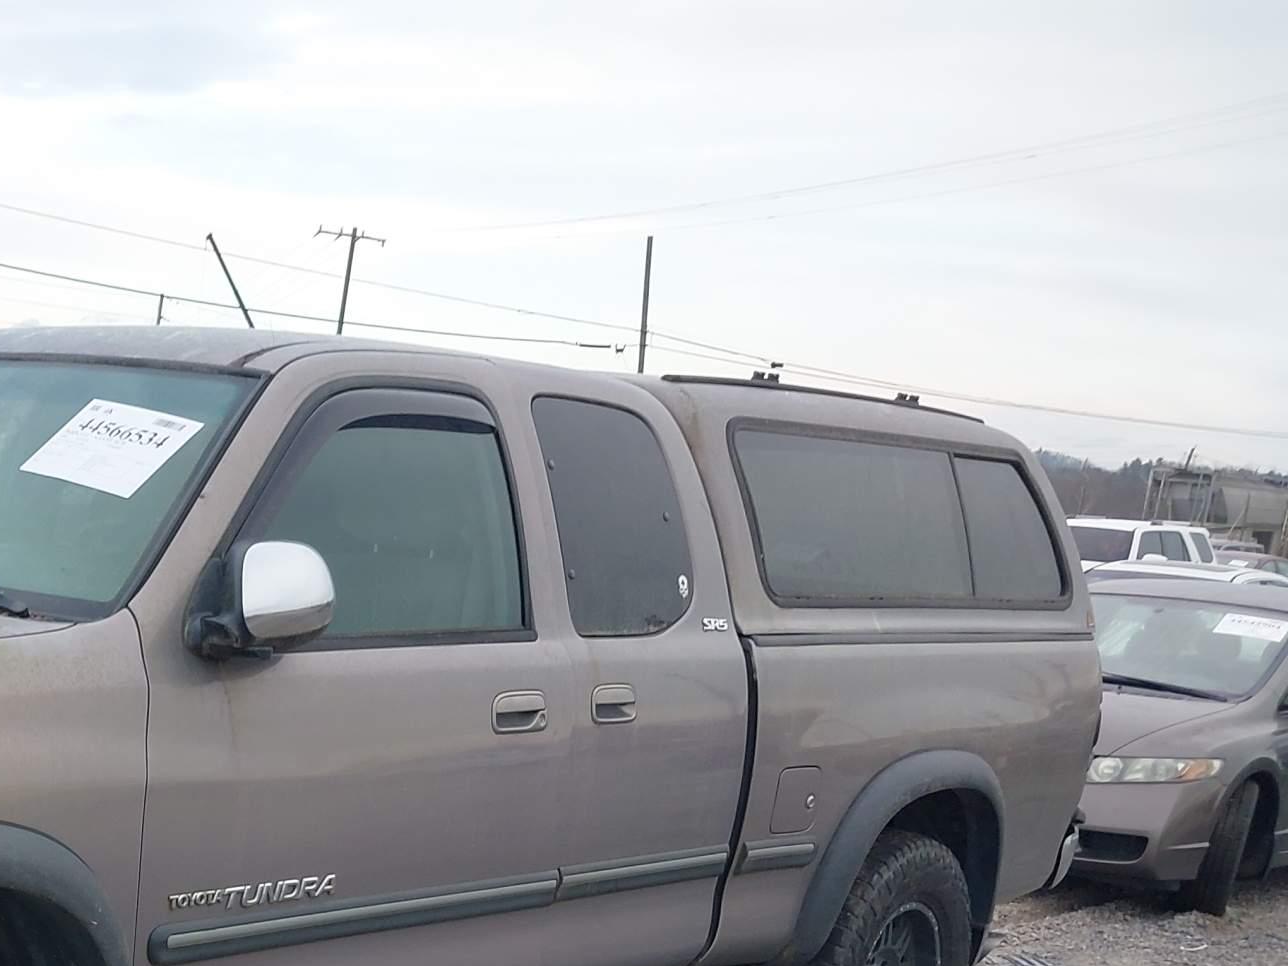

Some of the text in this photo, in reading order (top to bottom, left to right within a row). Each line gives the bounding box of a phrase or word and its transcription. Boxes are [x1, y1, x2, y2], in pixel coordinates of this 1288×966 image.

[79, 418, 171, 449] 44566534
[702, 617, 729, 631] SR5
[168, 873, 337, 911] TOYOTA TUNDRA
